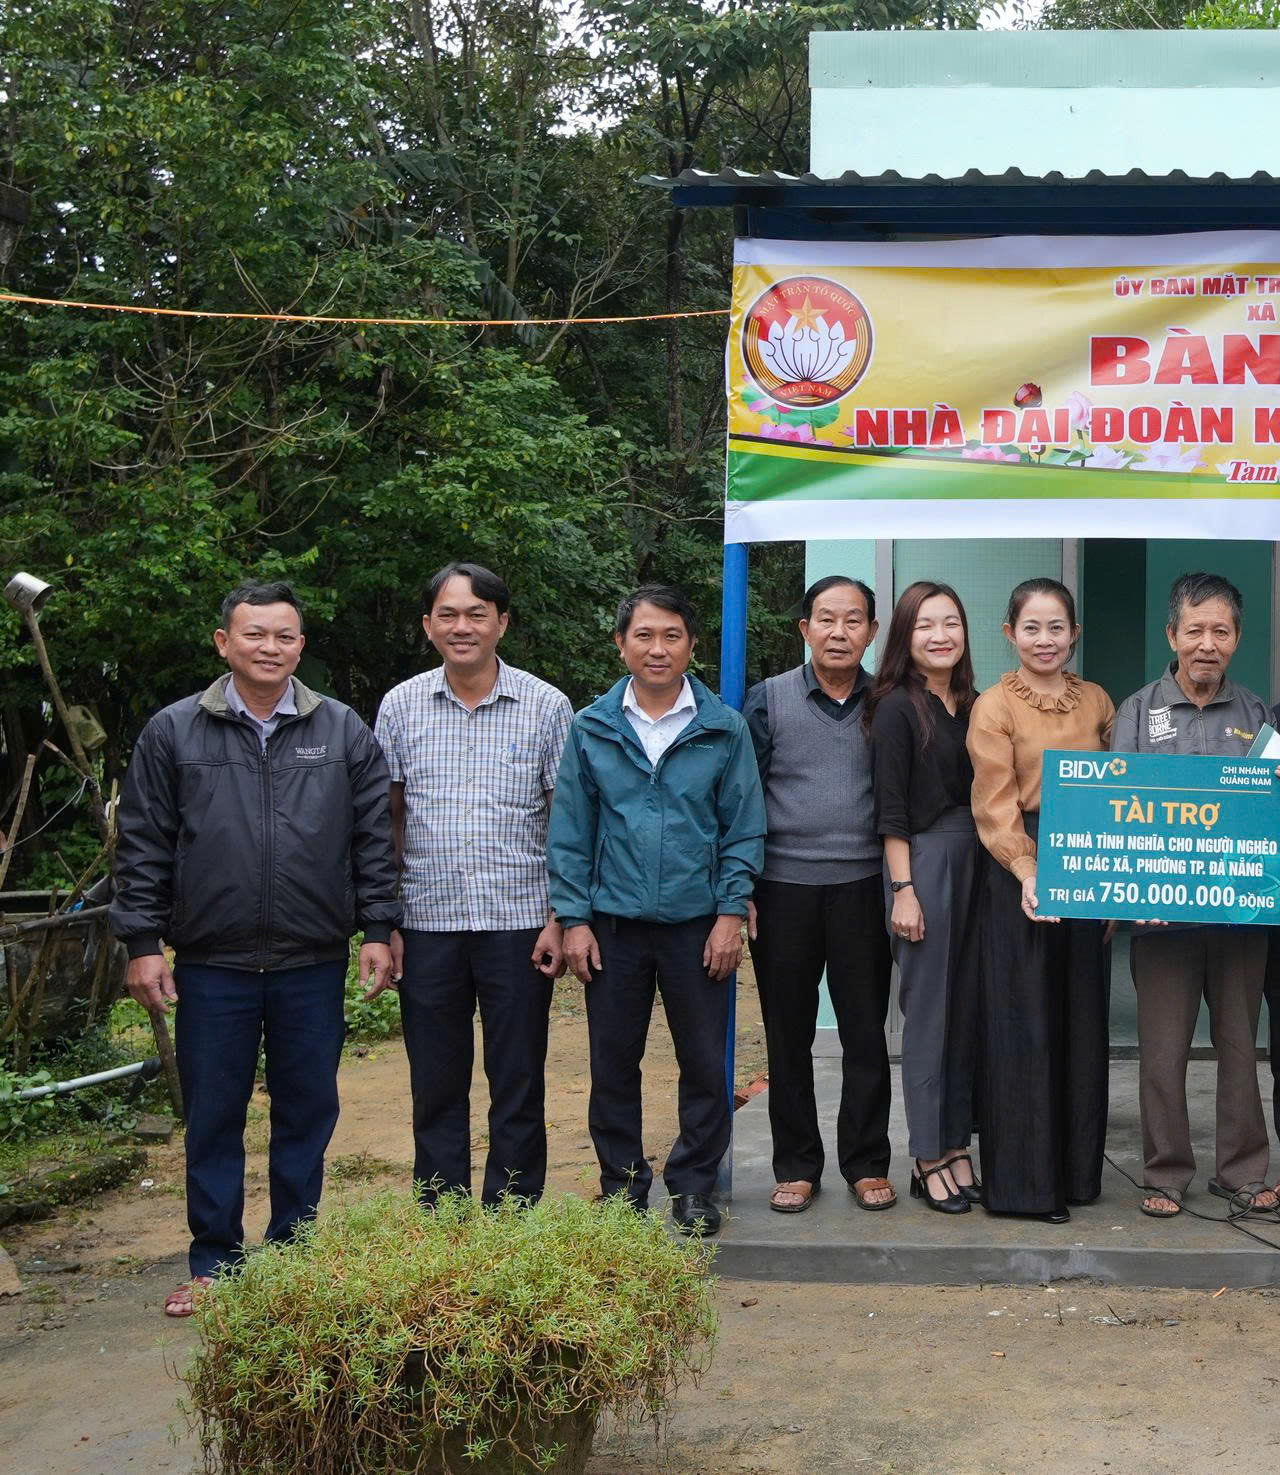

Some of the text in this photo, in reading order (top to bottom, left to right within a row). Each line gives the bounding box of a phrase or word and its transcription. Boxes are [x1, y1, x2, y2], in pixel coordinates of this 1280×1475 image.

[1115, 276, 1144, 296] ỦY
[1151, 278, 1195, 295] BAN
[1202, 274, 1249, 298] MẶT
[1248, 302, 1275, 321] XÃ
[808, 384, 833, 397] NAM
[855, 403, 965, 446] NHÀ
[981, 409, 1070, 450] ĐẠI
[1088, 401, 1233, 443] ĐOÀN
[1229, 461, 1277, 483] Tam
[1059, 759, 1110, 779] BIDV
[1222, 766, 1270, 775] CHI NHÁNH
[1220, 775, 1249, 785] QUẢNG
[1109, 795, 1220, 831] TÀI TRỢ
[1049, 831, 1278, 855] 12 NHÀ TÌNH NGHĨA CHO NGƯỜI NGHÈO
[1062, 855, 1081, 873] TẠI
[1084, 854, 1110, 871] CÁC
[1113, 855, 1133, 874] XÃ,
[1136, 856, 1186, 874] PHƯỜNG
[1190, 860, 1206, 875] TP.
[1209, 858, 1225, 875] ĐÀ
[1049, 881, 1274, 908] TRỊ GIÁ 750.000.000 ĐỒNG
